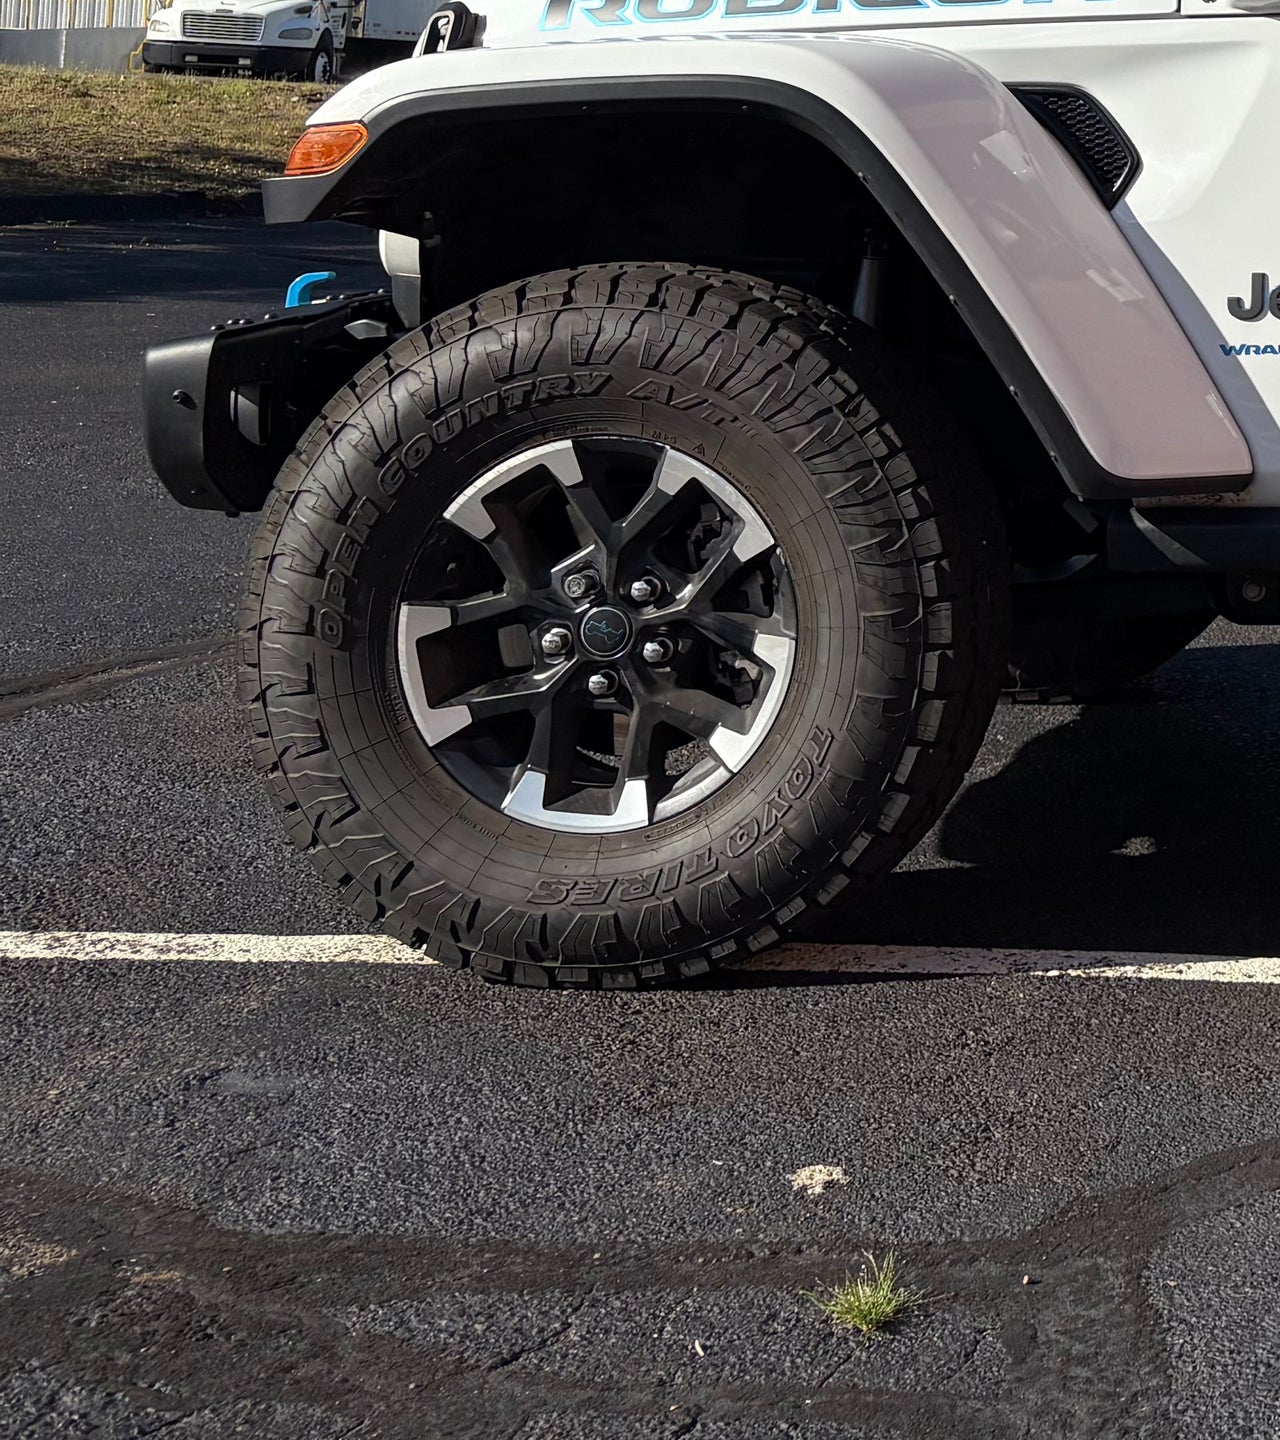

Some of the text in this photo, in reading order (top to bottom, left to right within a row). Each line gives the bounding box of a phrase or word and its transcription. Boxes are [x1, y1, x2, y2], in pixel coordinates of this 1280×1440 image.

[317, 496, 380, 648] OPEN
[378, 371, 612, 496] COUNTRY
[724, 725, 834, 859] TOYO
[526, 847, 719, 906] TIRES
